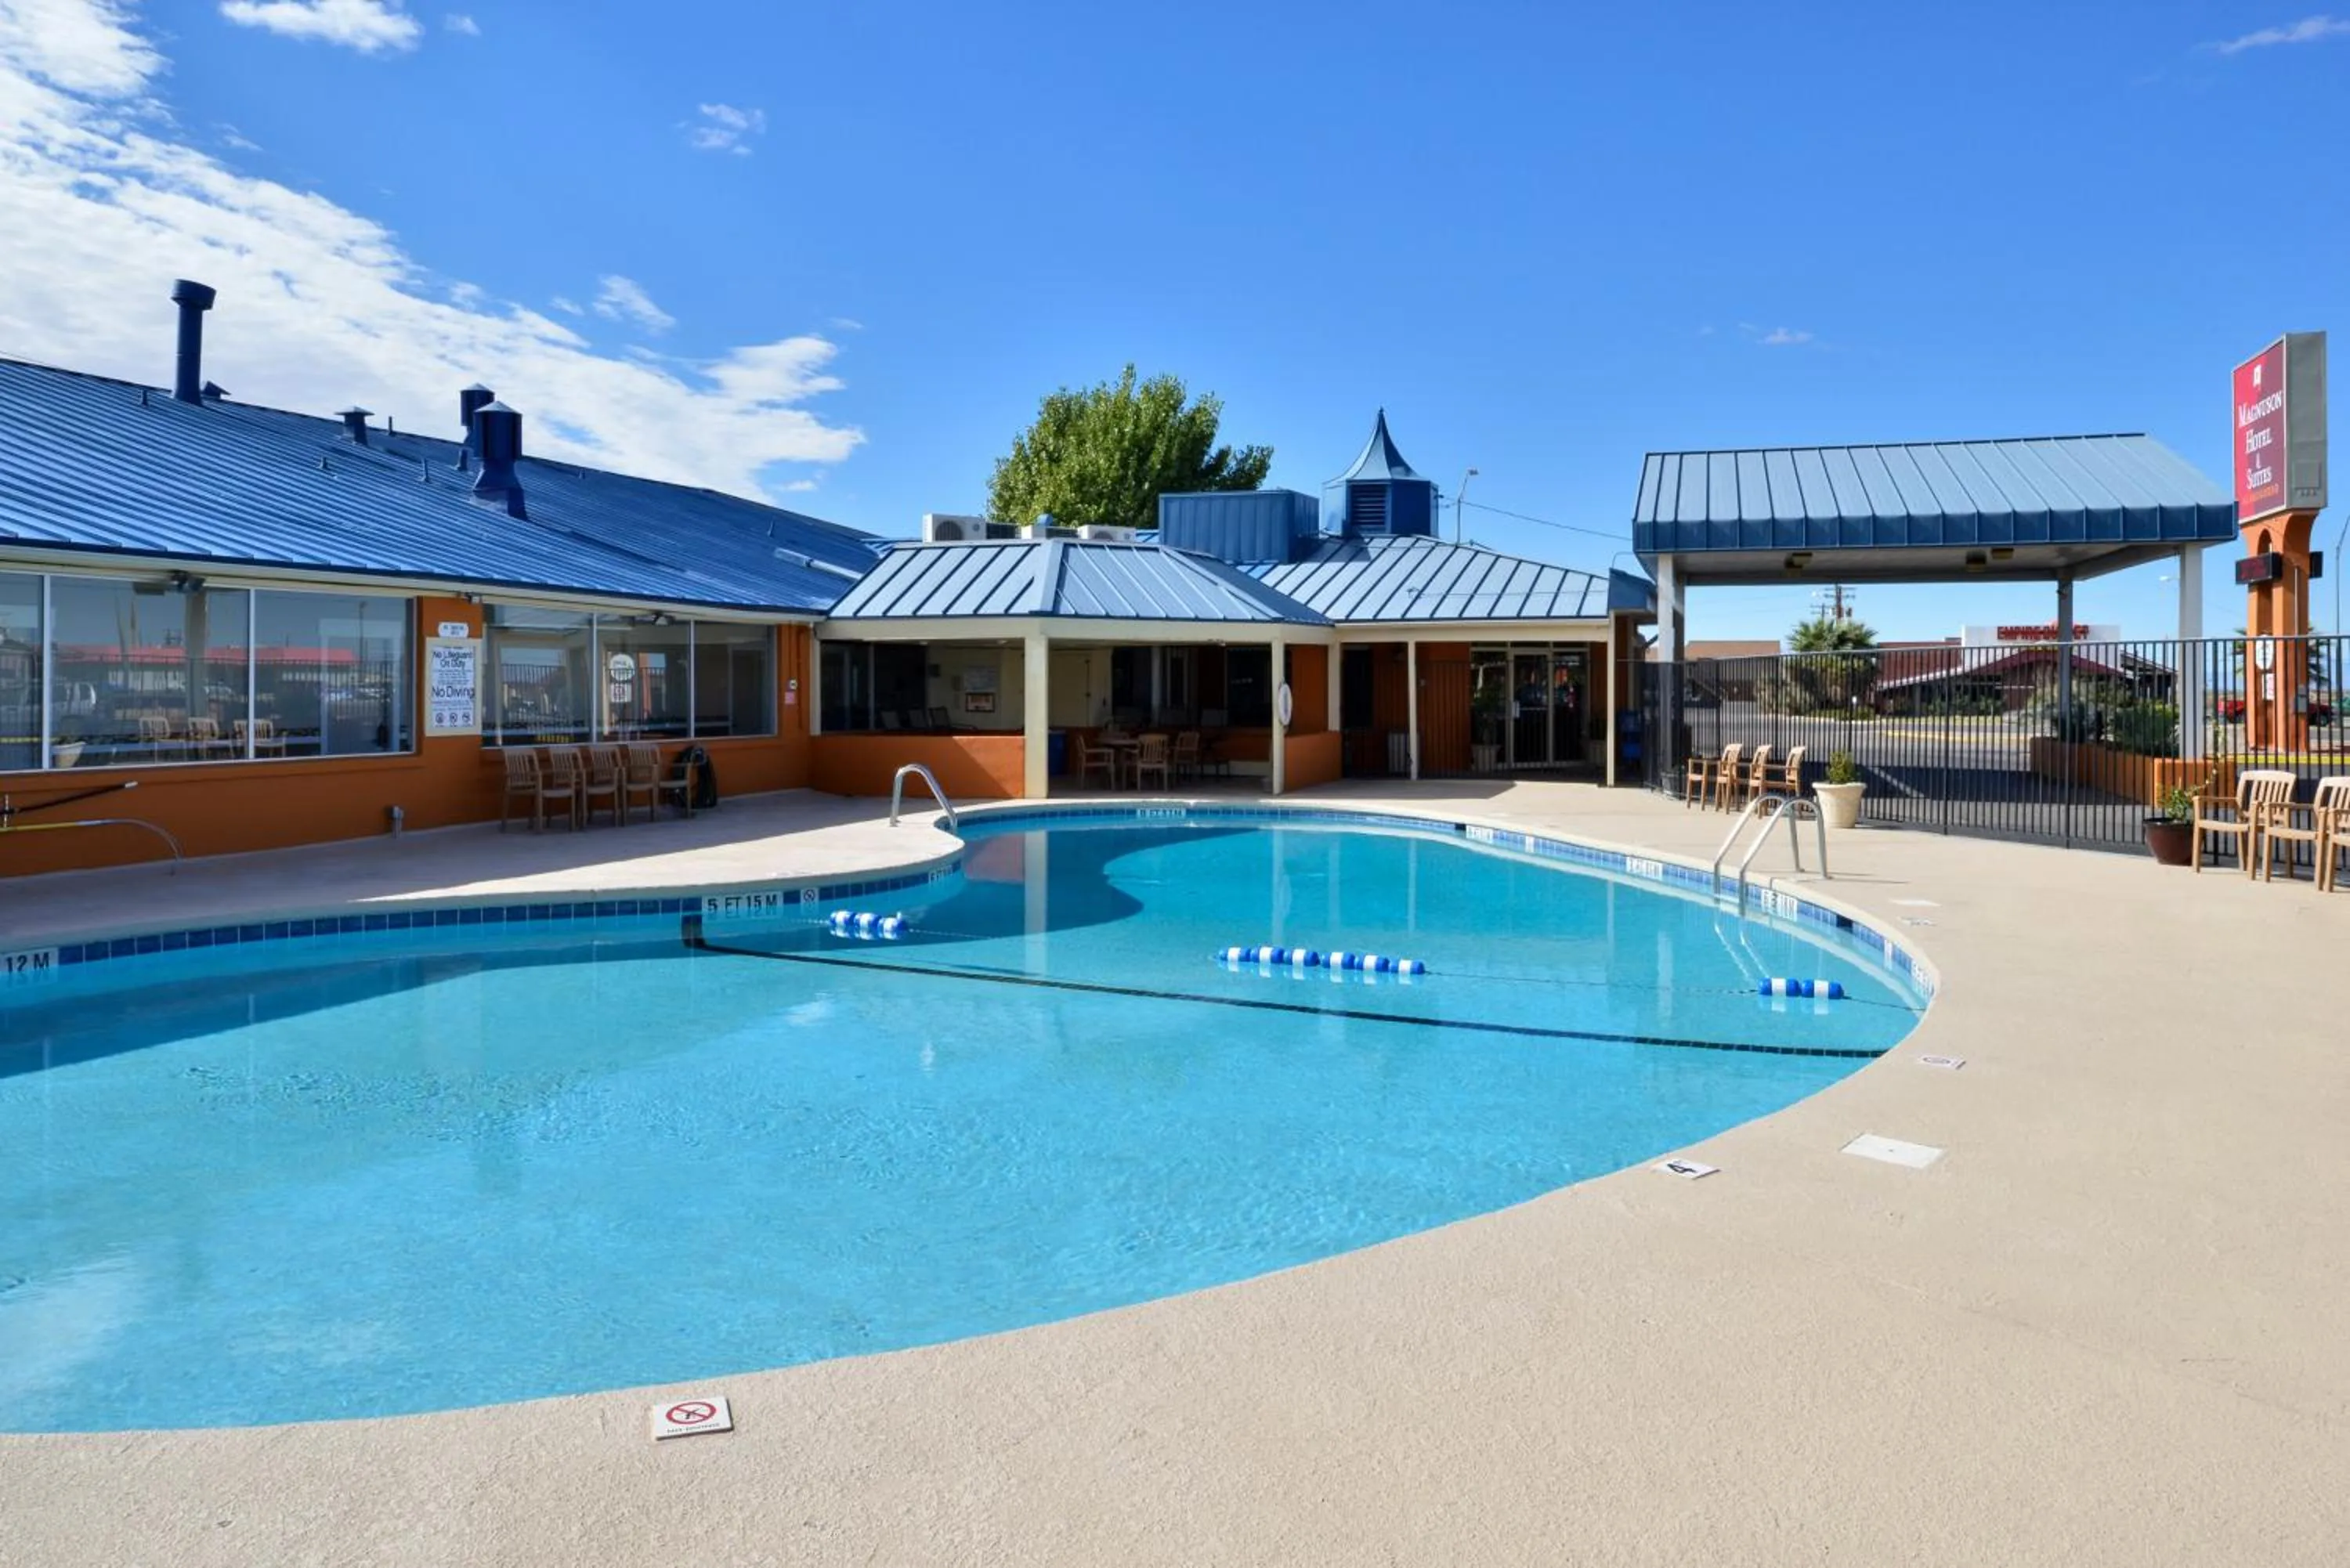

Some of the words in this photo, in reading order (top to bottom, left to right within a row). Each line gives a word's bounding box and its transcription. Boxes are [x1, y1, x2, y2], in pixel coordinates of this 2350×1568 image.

[2238, 390, 2283, 428] MAGNUSON
[2245, 428, 2272, 453] HOTEL
[2247, 467, 2272, 490] SUITES
[451, 659, 466, 671] Duty
[432, 687, 445, 698] No
[446, 686, 475, 699] Diving
[707, 898, 718, 912] 5
[725, 896, 742, 911] FT
[765, 893, 779, 907] M
[5, 955, 27, 973] 12
[34, 952, 49, 969] M
